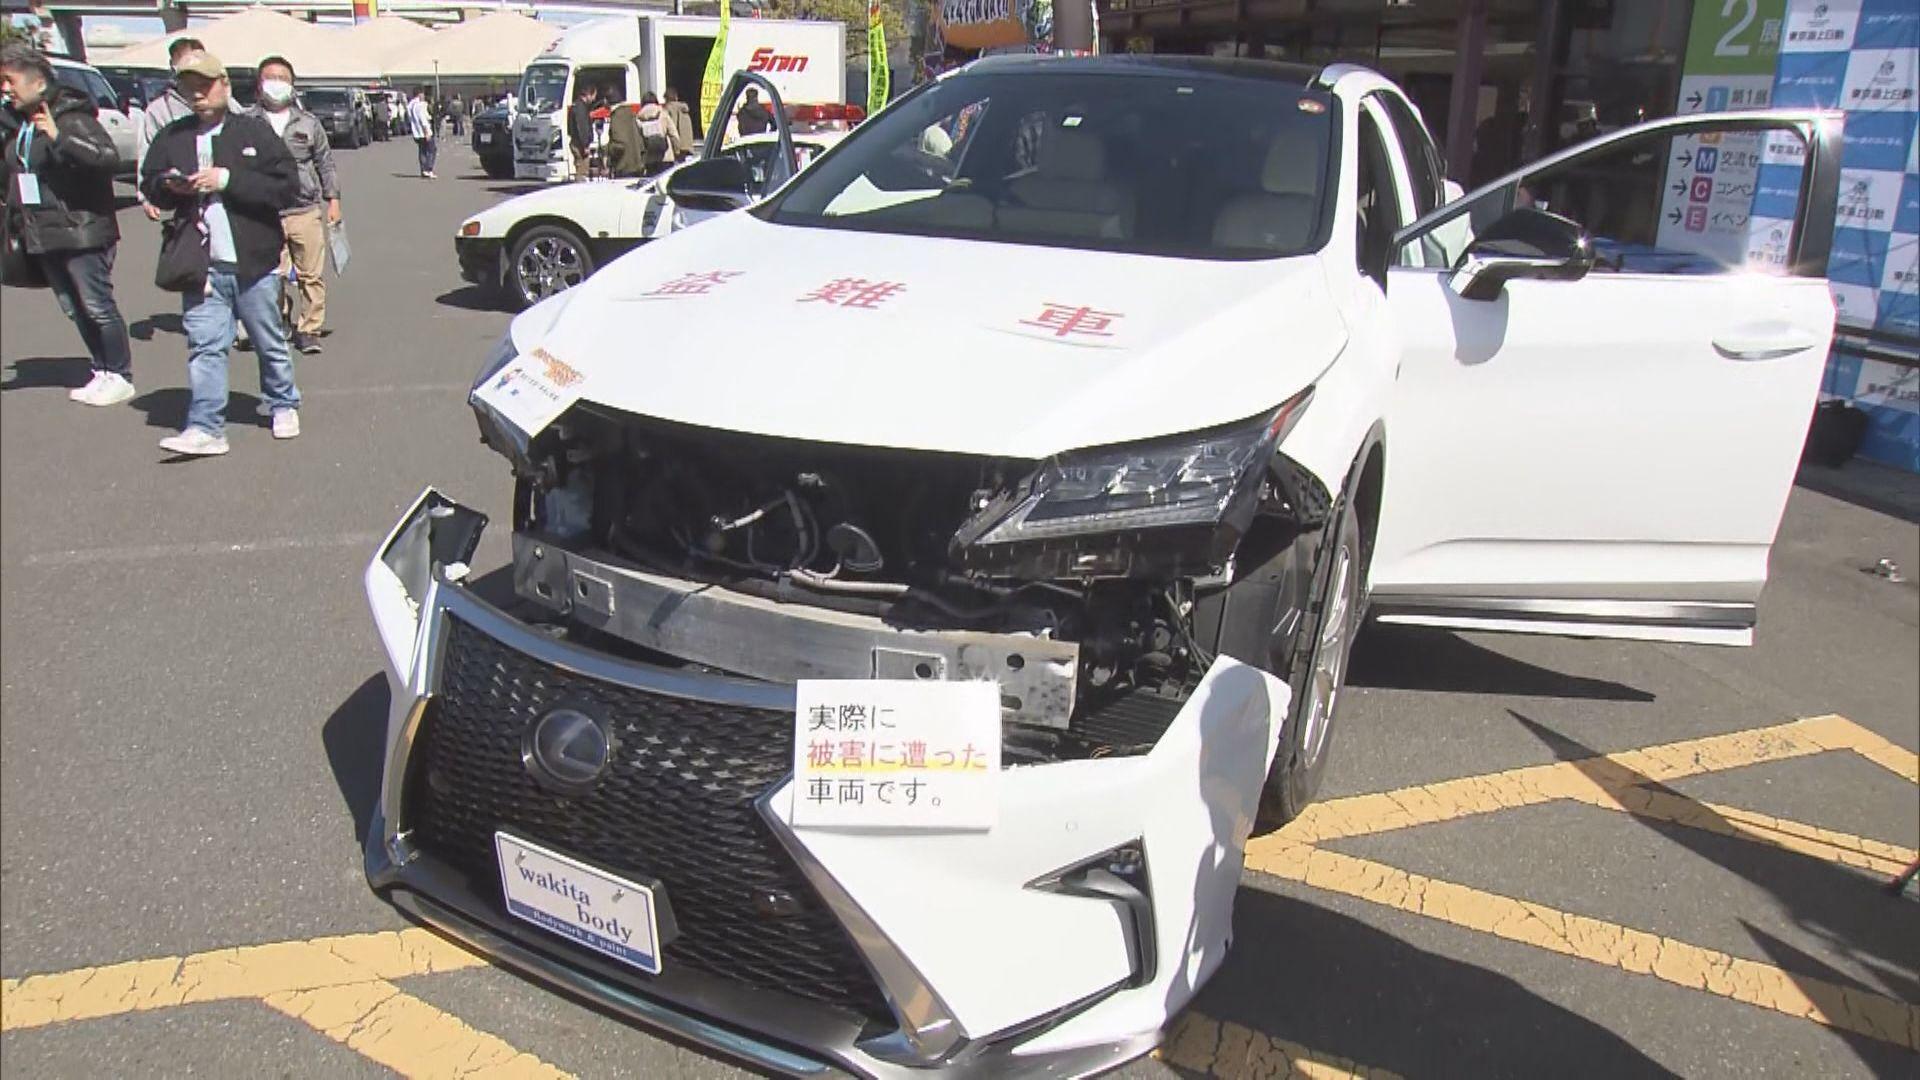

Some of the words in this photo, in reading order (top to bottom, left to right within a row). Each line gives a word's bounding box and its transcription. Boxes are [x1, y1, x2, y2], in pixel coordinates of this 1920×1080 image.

[1713, 0, 1758, 56] 2
[1698, 151, 1716, 172] M
[1694, 181, 1708, 199] C
[808, 703, 896, 732] 実際に
[807, 739, 987, 769] 被害に遭った
[806, 777, 942, 807] 車両です。
[519, 866, 591, 906] wakita
[577, 903, 633, 944] body
